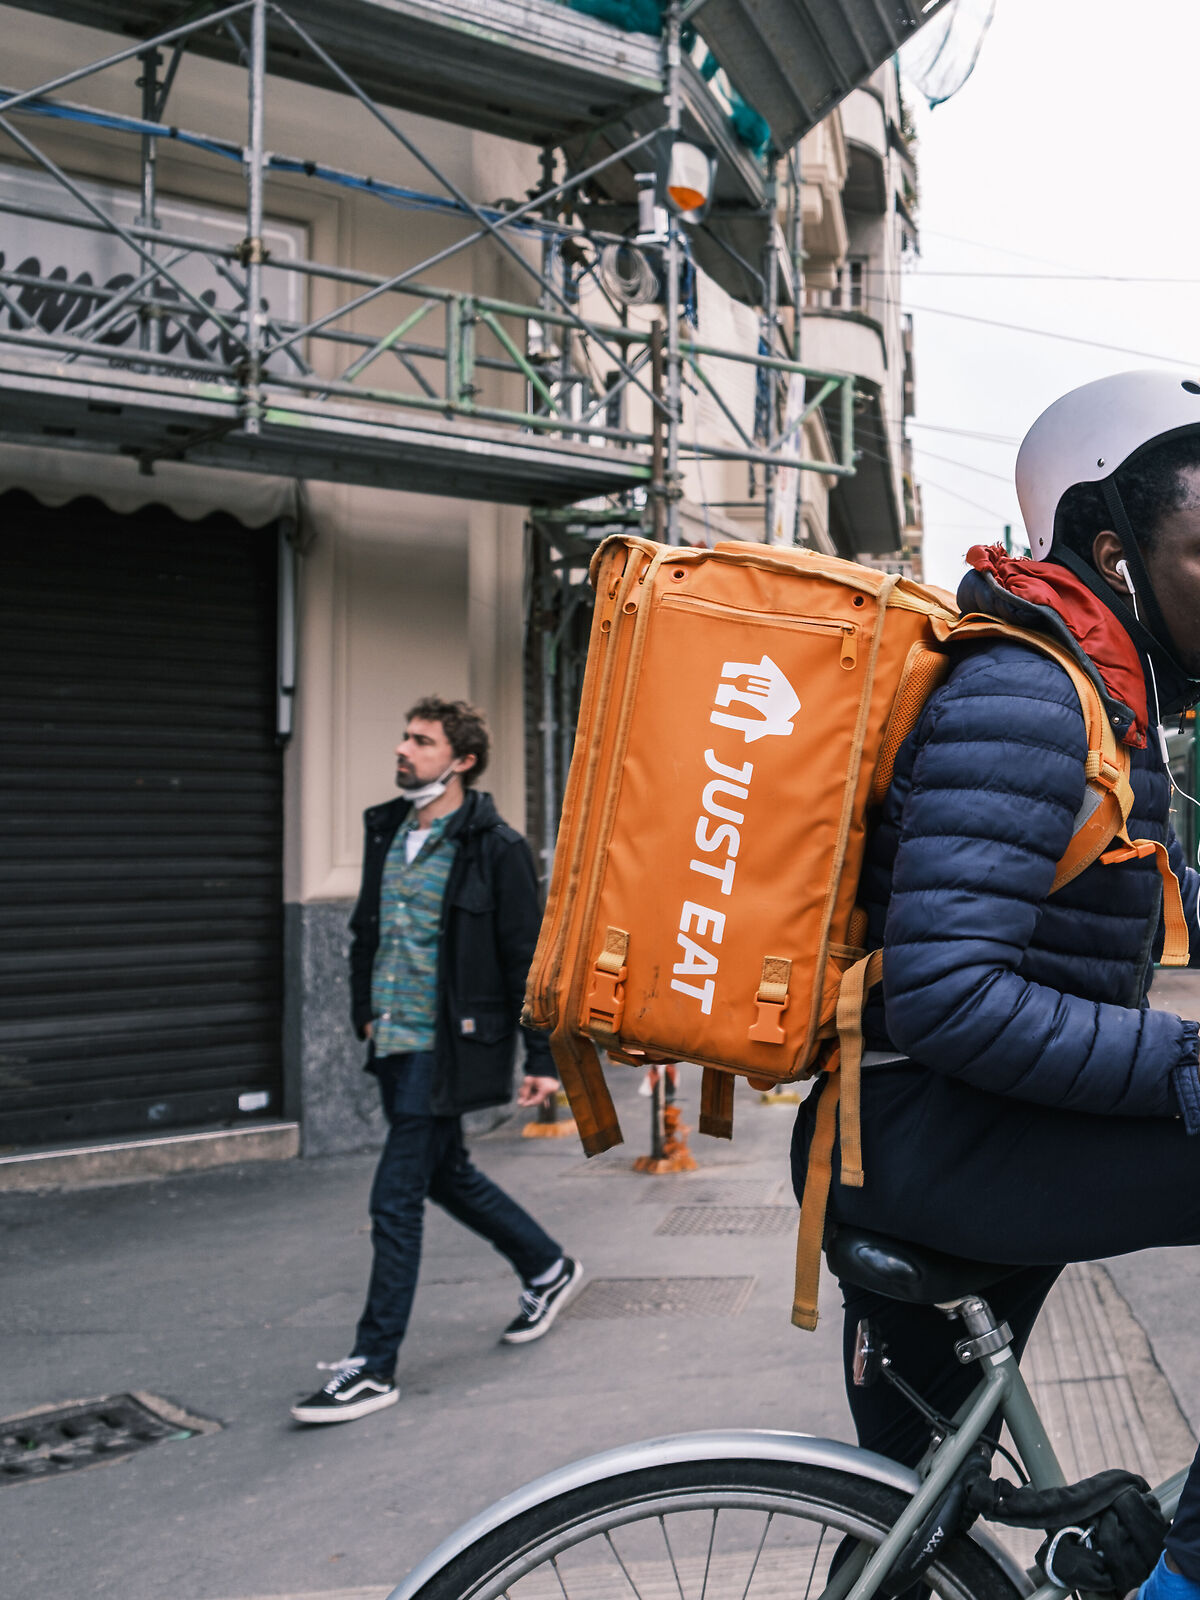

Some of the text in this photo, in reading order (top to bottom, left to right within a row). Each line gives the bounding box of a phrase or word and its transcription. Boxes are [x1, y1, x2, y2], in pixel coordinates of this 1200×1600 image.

[670, 749, 754, 1015] JUST EAT
[923, 1526, 944, 1553] AXA
